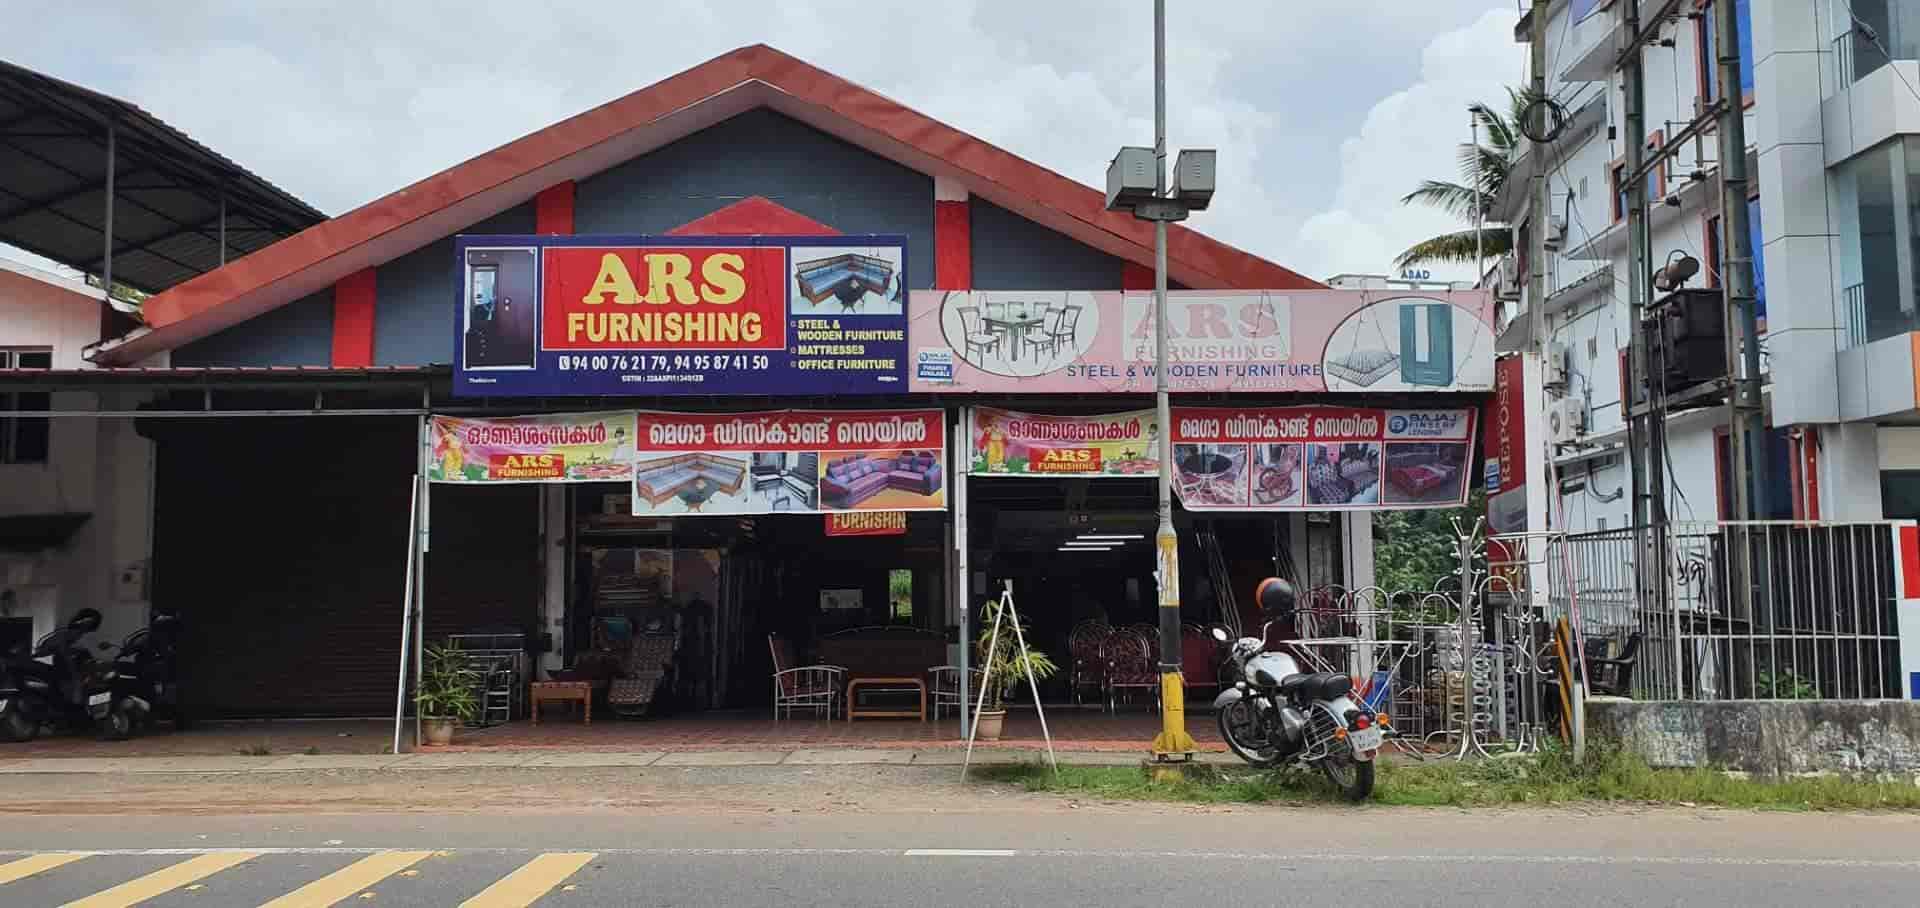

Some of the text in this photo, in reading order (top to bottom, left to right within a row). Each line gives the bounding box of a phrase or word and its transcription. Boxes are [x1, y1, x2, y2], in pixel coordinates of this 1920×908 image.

[582, 253, 746, 304] ARS
[1400, 269, 1430, 280] ABAD
[567, 312, 762, 343] FURNISHING
[797, 319, 841, 330] STEEL &
[1131, 303, 1279, 340] ARS
[797, 330, 904, 341] WOODEN FURNITURE
[797, 345, 865, 355] MATTRESSES
[572, 355, 588, 370] 94
[592, 355, 608, 370] 00
[612, 355, 628, 370] 76
[631, 355, 646, 370] 21
[674, 355, 690, 370] 94
[694, 355, 710, 370] 95
[714, 355, 730, 370] 87
[733, 355, 748, 370] 41
[752, 355, 769, 370] 50
[797, 360, 896, 370] OFFICE FURNITURE
[1067, 364, 1321, 377] STEEL & WODEN FURNITURE
[1498, 368, 1511, 482] REPOSE
[650, 424, 705, 445] മെഗാ
[504, 455, 553, 467] ARS
[1044, 449, 1091, 462] ARS
[497, 466, 559, 477] FURNISHING
[1038, 462, 1096, 472] FURNISHING
[832, 512, 907, 529] FURNISHIN
